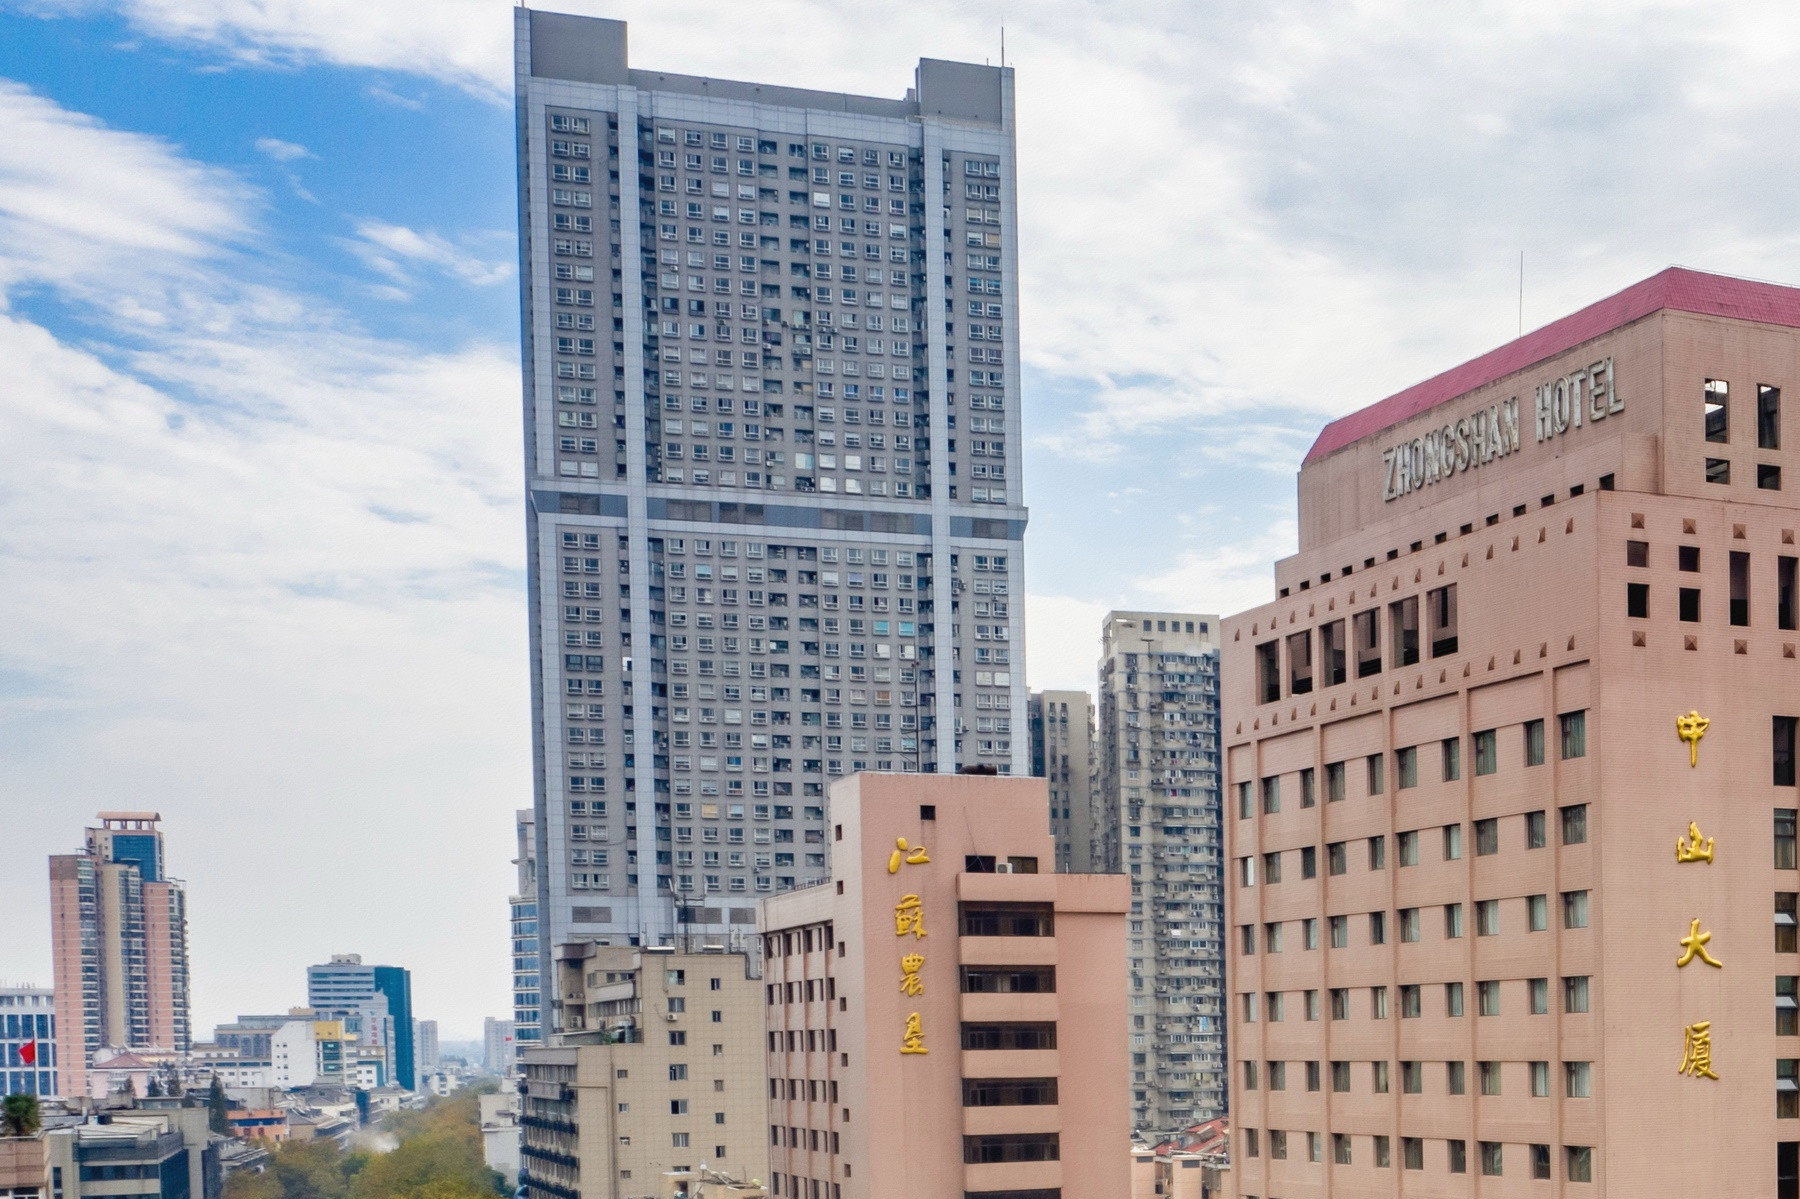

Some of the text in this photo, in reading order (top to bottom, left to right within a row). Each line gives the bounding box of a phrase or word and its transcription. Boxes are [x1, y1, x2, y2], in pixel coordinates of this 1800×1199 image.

[1382, 356, 1625, 502] ZHONGSHAN HOTEL
[1675, 710, 1723, 1081] 中山大厦
